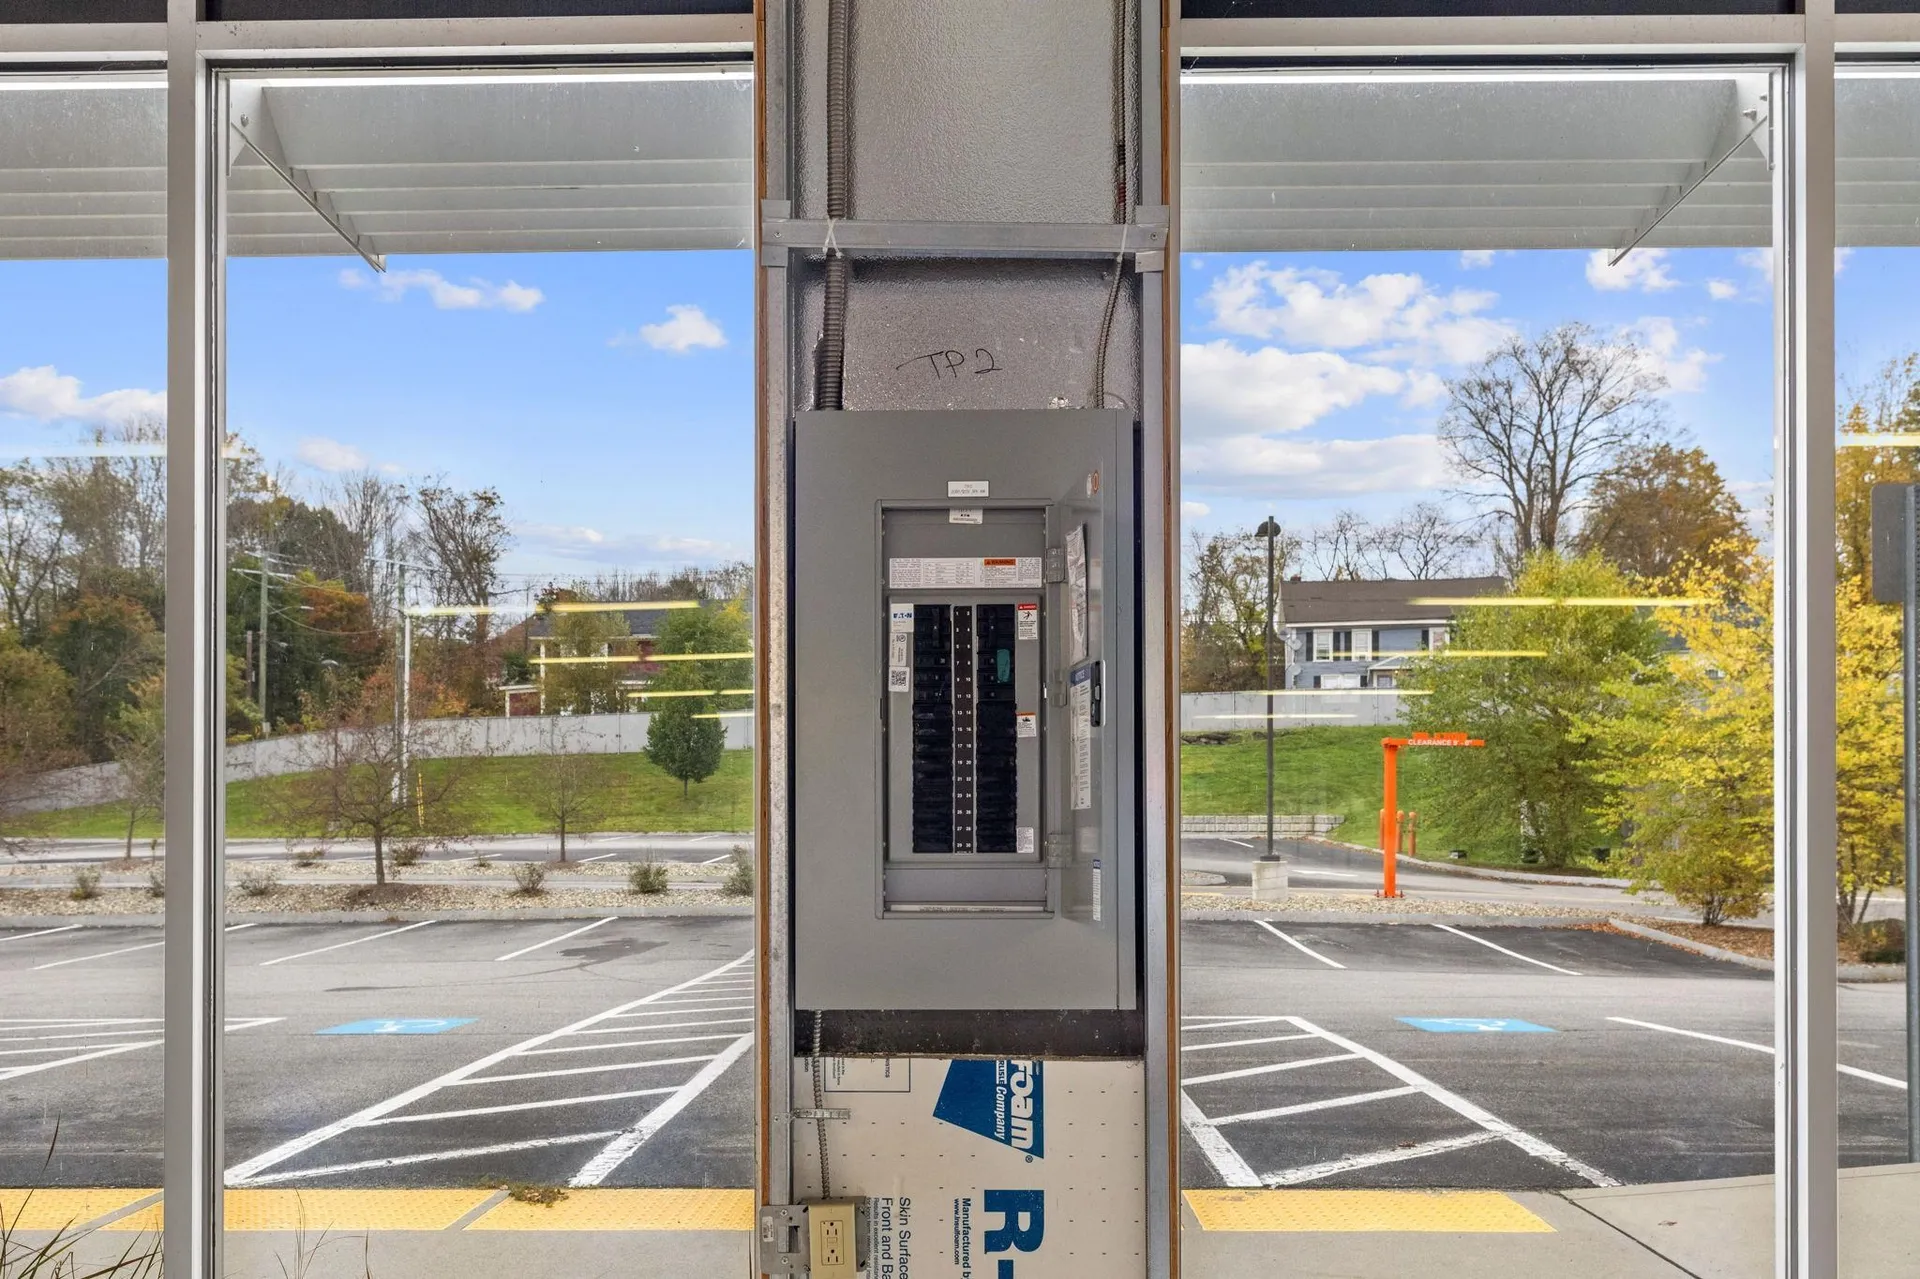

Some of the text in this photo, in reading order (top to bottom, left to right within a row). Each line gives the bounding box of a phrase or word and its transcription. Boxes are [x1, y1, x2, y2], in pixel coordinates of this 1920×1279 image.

[994, 1086, 1008, 1140] Company
[881, 1197, 893, 1232] Front
[899, 1197, 912, 1279] Skin Surface
[962, 1198, 972, 1268] Manufactured
[881, 1235, 894, 1260] and
